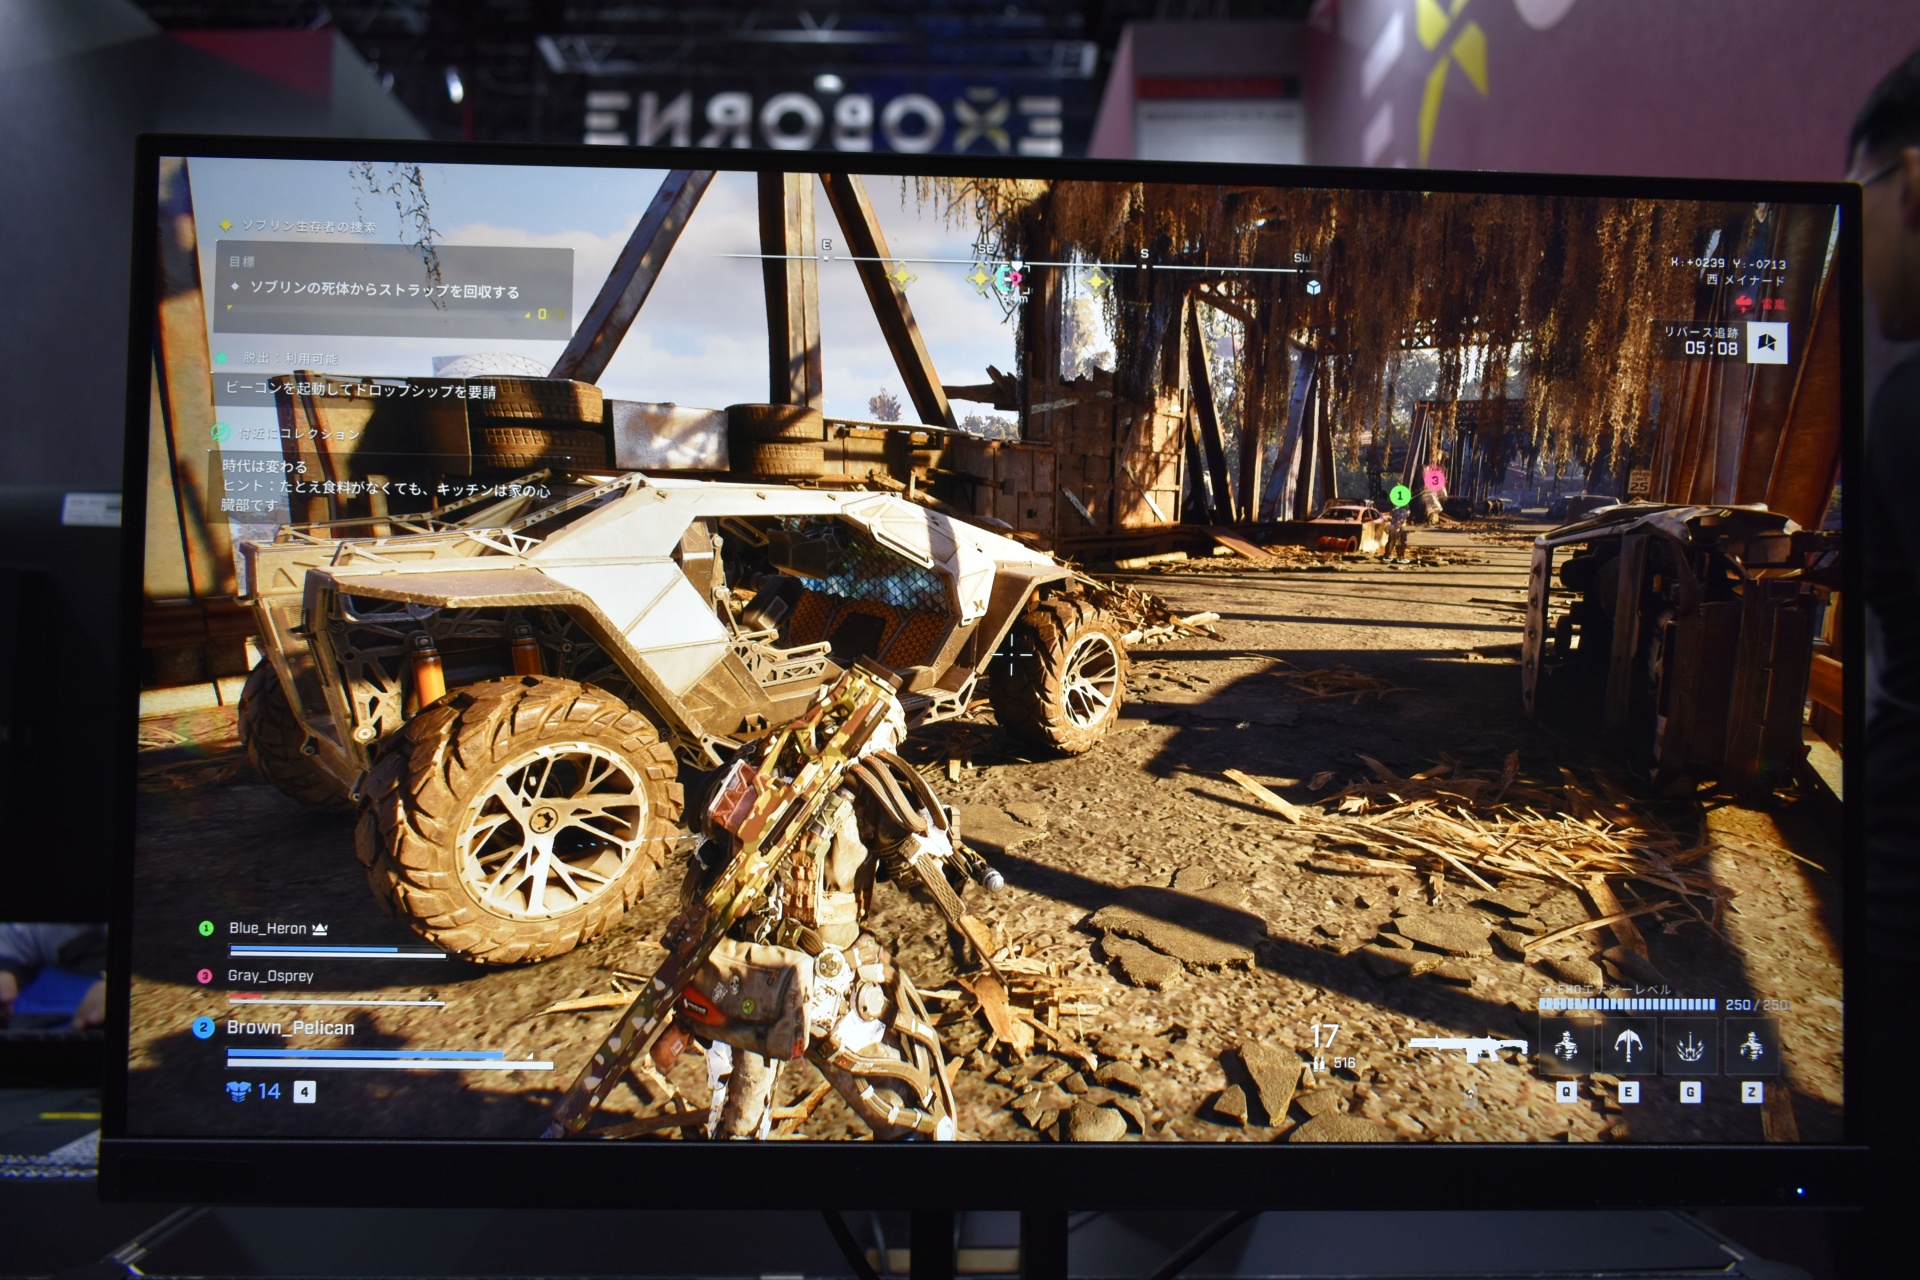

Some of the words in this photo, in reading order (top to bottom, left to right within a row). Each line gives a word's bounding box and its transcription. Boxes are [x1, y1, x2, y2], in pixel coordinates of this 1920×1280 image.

[242, 219, 377, 234] ソブリン生存者の捜索
[821, 239, 832, 250] E
[977, 244, 995, 254] SE
[1140, 248, 1149, 259] S
[229, 255, 255, 268] 目標
[1732, 258, 1787, 270] Y:-0713
[1707, 274, 1718, 285] 西
[1724, 275, 1785, 287] メイナード
[250, 280, 520, 300] ソブリンの死体からストラップを回収する
[1664, 326, 1739, 339] リバース追跡
[1685, 341, 1738, 356] 05:08
[226, 380, 497, 400] ビーコンを起動してドロップシップを要請
[238, 426, 360, 441] 付近にコレクション
[222, 459, 308, 474] 時代は変わる
[1432, 475, 1439, 485] 3
[1630, 482, 1648, 492] 25
[1397, 491, 1403, 500] 1
[221, 498, 279, 513] 臓部です
[204, 924, 209, 932] 1
[230, 921, 306, 936] Blue_Heron
[202, 971, 209, 980] 3
[228, 969, 314, 984] Gray_Osprey
[200, 1022, 208, 1032] 2
[227, 1020, 355, 1037] Brown_Pelican
[1311, 1024, 1340, 1048] 17
[1334, 1057, 1356, 1068] 516
[258, 1083, 281, 1099] 14
[300, 1086, 309, 1097] 4
[1562, 1086, 1571, 1097] Q
[1624, 1086, 1632, 1097] E
[1686, 1086, 1694, 1097] G
[1748, 1086, 1756, 1097] Z
